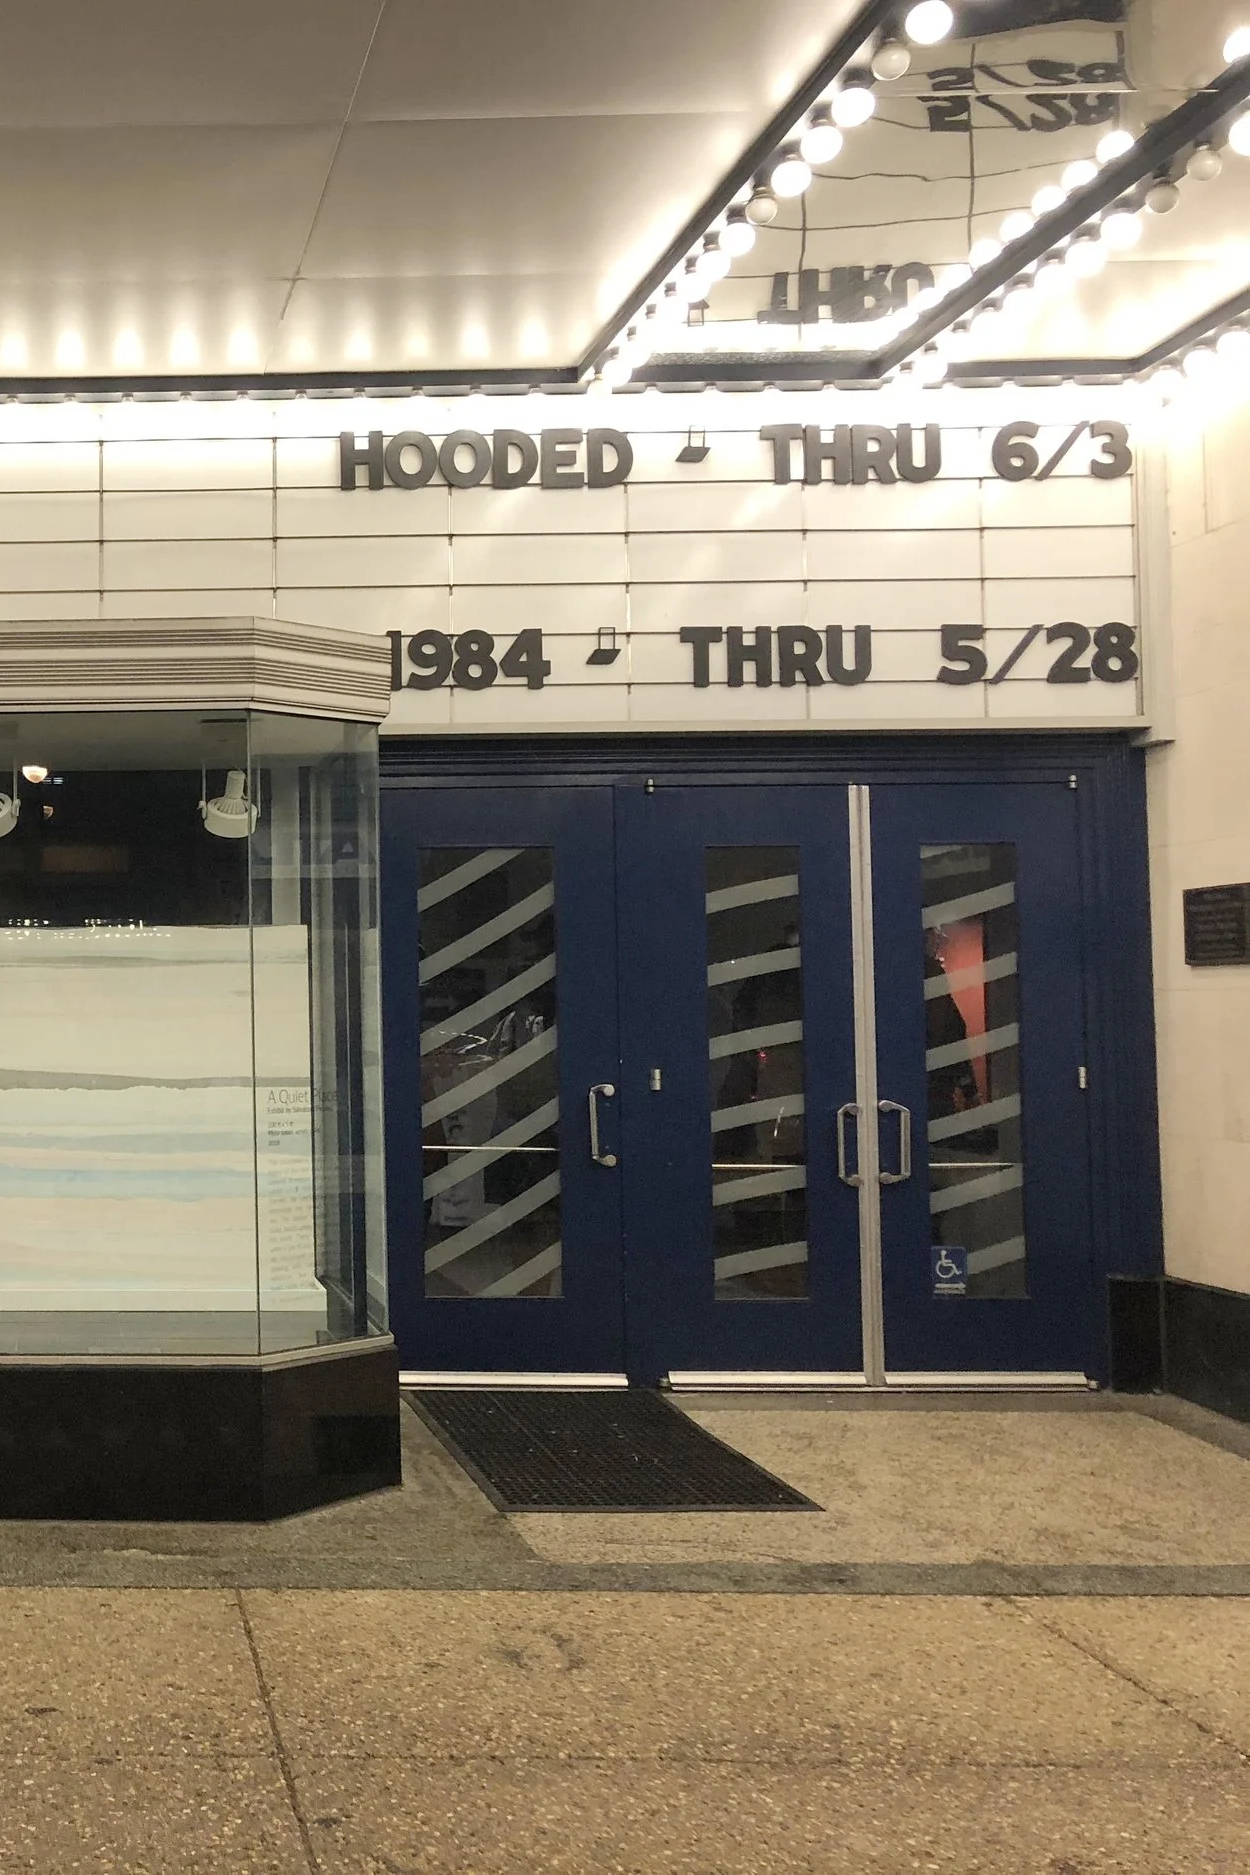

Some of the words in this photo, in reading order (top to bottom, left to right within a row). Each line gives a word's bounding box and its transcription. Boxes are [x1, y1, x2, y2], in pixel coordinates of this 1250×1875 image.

[339, 428, 634, 490] HOODED
[760, 423, 942, 485] THRU
[992, 420, 1133, 481] 6/3
[386, 628, 552, 691] 1984
[680, 625, 872, 687] THRU
[937, 621, 1139, 685] 5/28
[267, 1090, 276, 1104] A
[278, 1089, 309, 1105] Quiet
